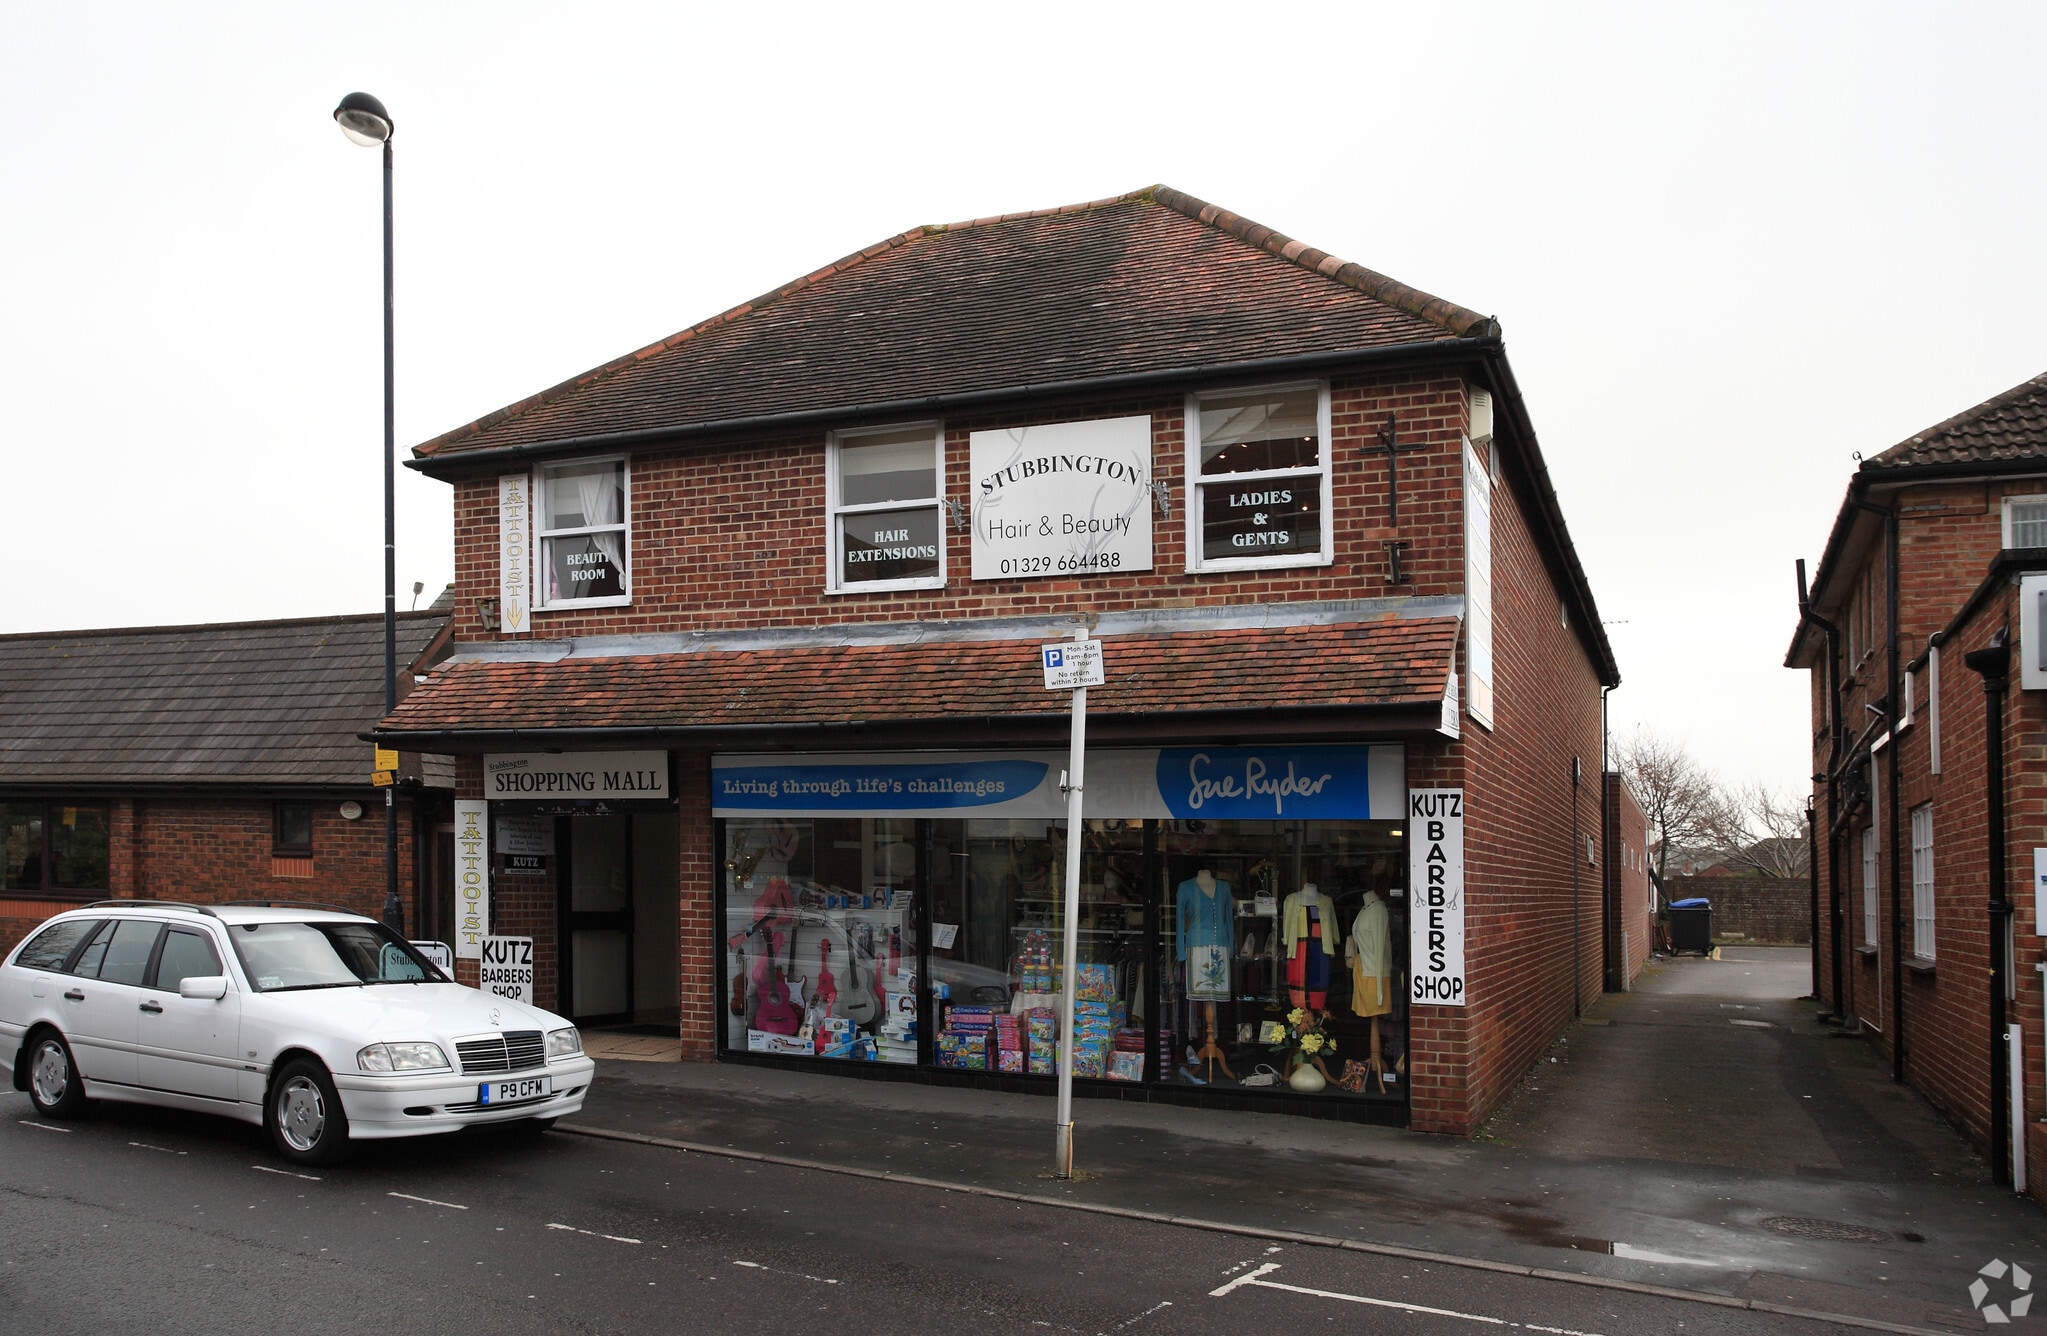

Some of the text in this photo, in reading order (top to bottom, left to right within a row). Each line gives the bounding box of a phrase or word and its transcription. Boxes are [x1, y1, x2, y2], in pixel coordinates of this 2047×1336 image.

[980, 454, 1141, 496] STUBBINGTON
[1229, 489, 1292, 507] LADIES
[988, 513, 1131, 540] Hair & Beauty
[1253, 512, 1268, 525] &
[502, 478, 525, 597] TATTOIST
[874, 529, 909, 543] HAIR
[1232, 530, 1289, 547] GENTS
[848, 544, 936, 563] EXTENSIONS
[1000, 552, 1121, 574] 01329 664488
[571, 568, 605, 581] ROOM
[1049, 651, 1060, 667] P
[488, 758, 528, 771] Stubbington
[495, 771, 662, 793] SHOPPING MALL
[723, 778, 1005, 797] Living through life's challenges
[1188, 753, 1332, 815] Sue Ryder
[1411, 794, 1462, 818] KUTZ
[513, 856, 539, 867] KUTZ
[457, 811, 484, 945] TATTOIST
[1426, 820, 1447, 973] BARBERS
[482, 940, 532, 964] KUTZ
[482, 968, 532, 984] BARBERS
[492, 986, 522, 1000] SHOP
[1413, 976, 1463, 1000] SHOP
[500, 1080, 543, 1099] P9 CFM
